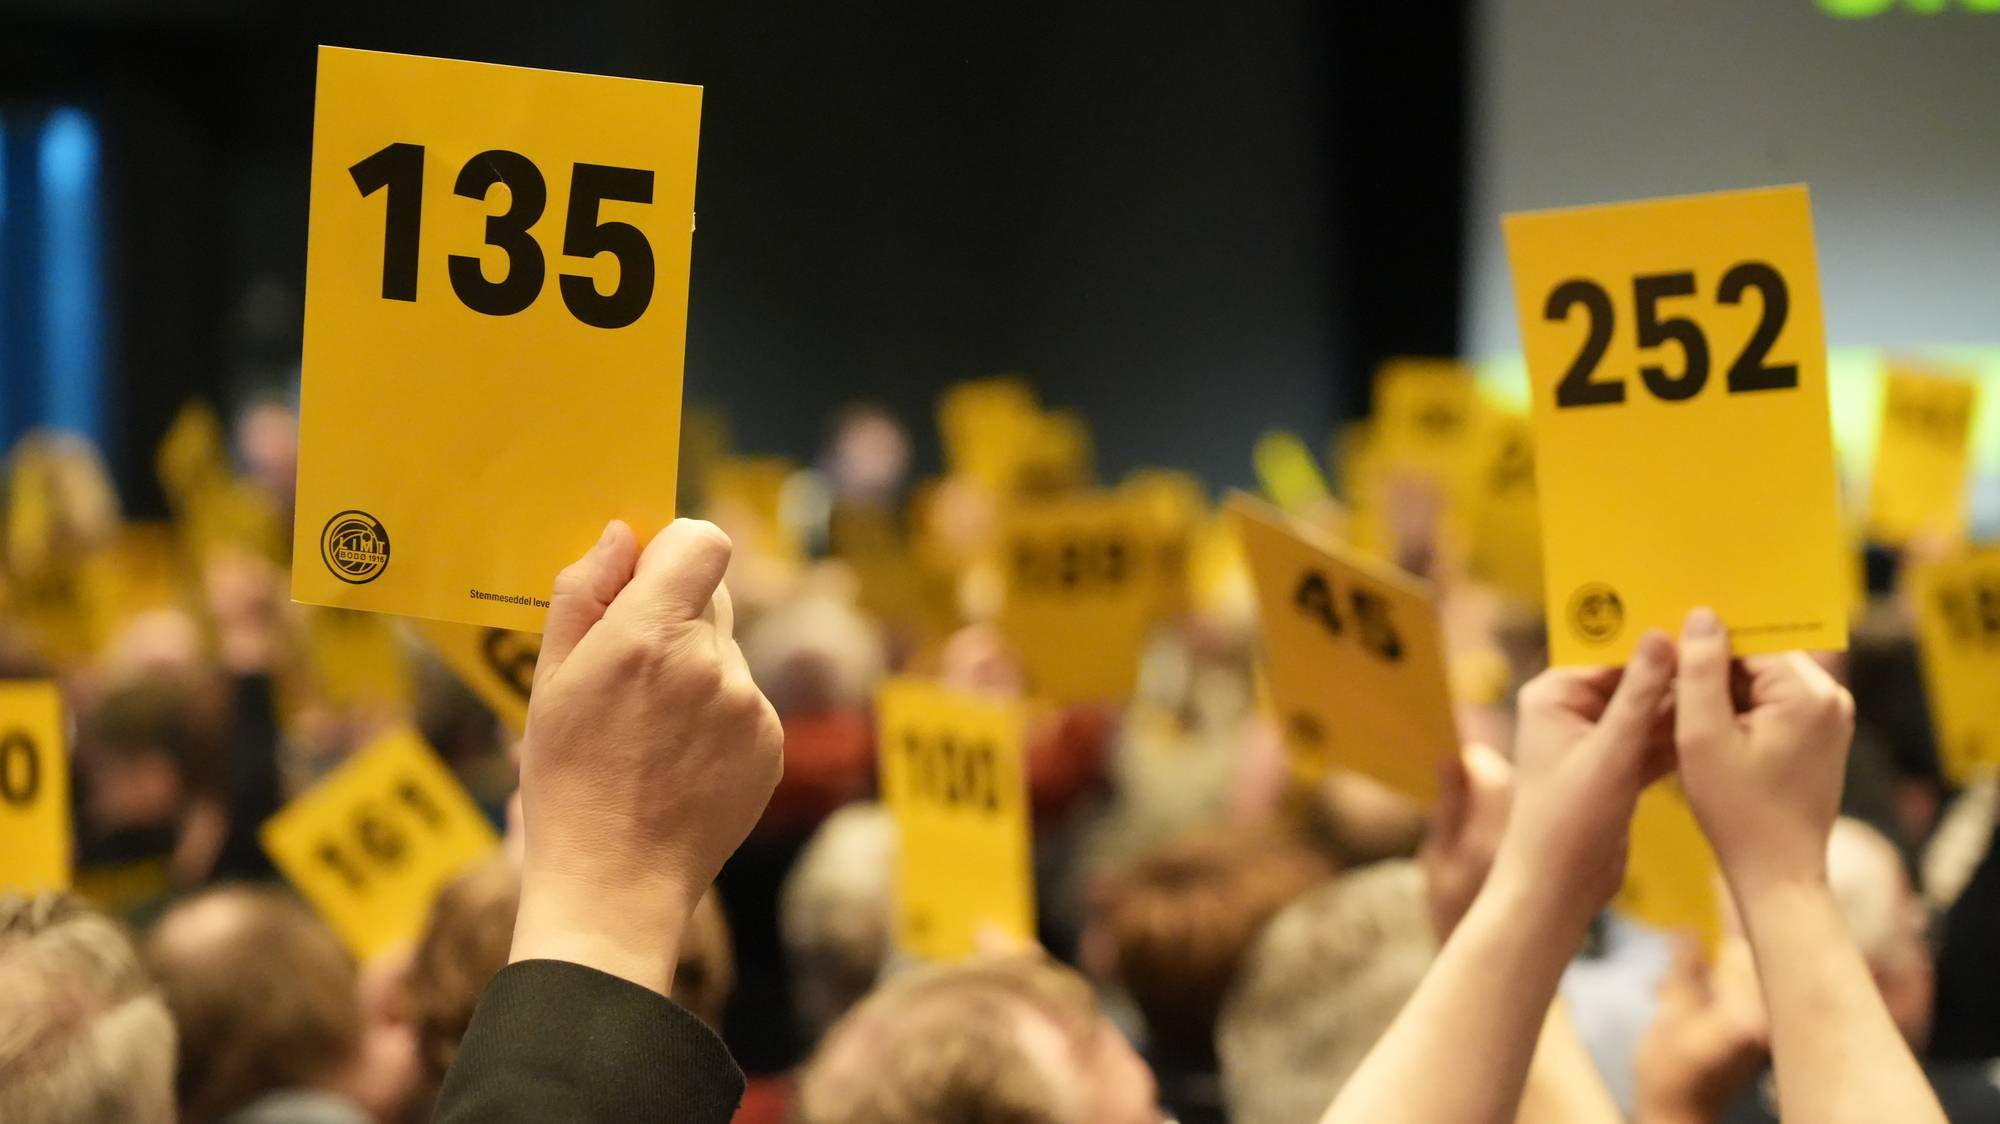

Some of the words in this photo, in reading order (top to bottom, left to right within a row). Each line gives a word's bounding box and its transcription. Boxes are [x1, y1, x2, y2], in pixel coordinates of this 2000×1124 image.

[348, 142, 655, 329] 135
[1542, 261, 1799, 411] 252
[469, 588, 532, 606] Stemmeseddel
[1293, 567, 1408, 665] 45
[314, 774, 448, 891] 161
